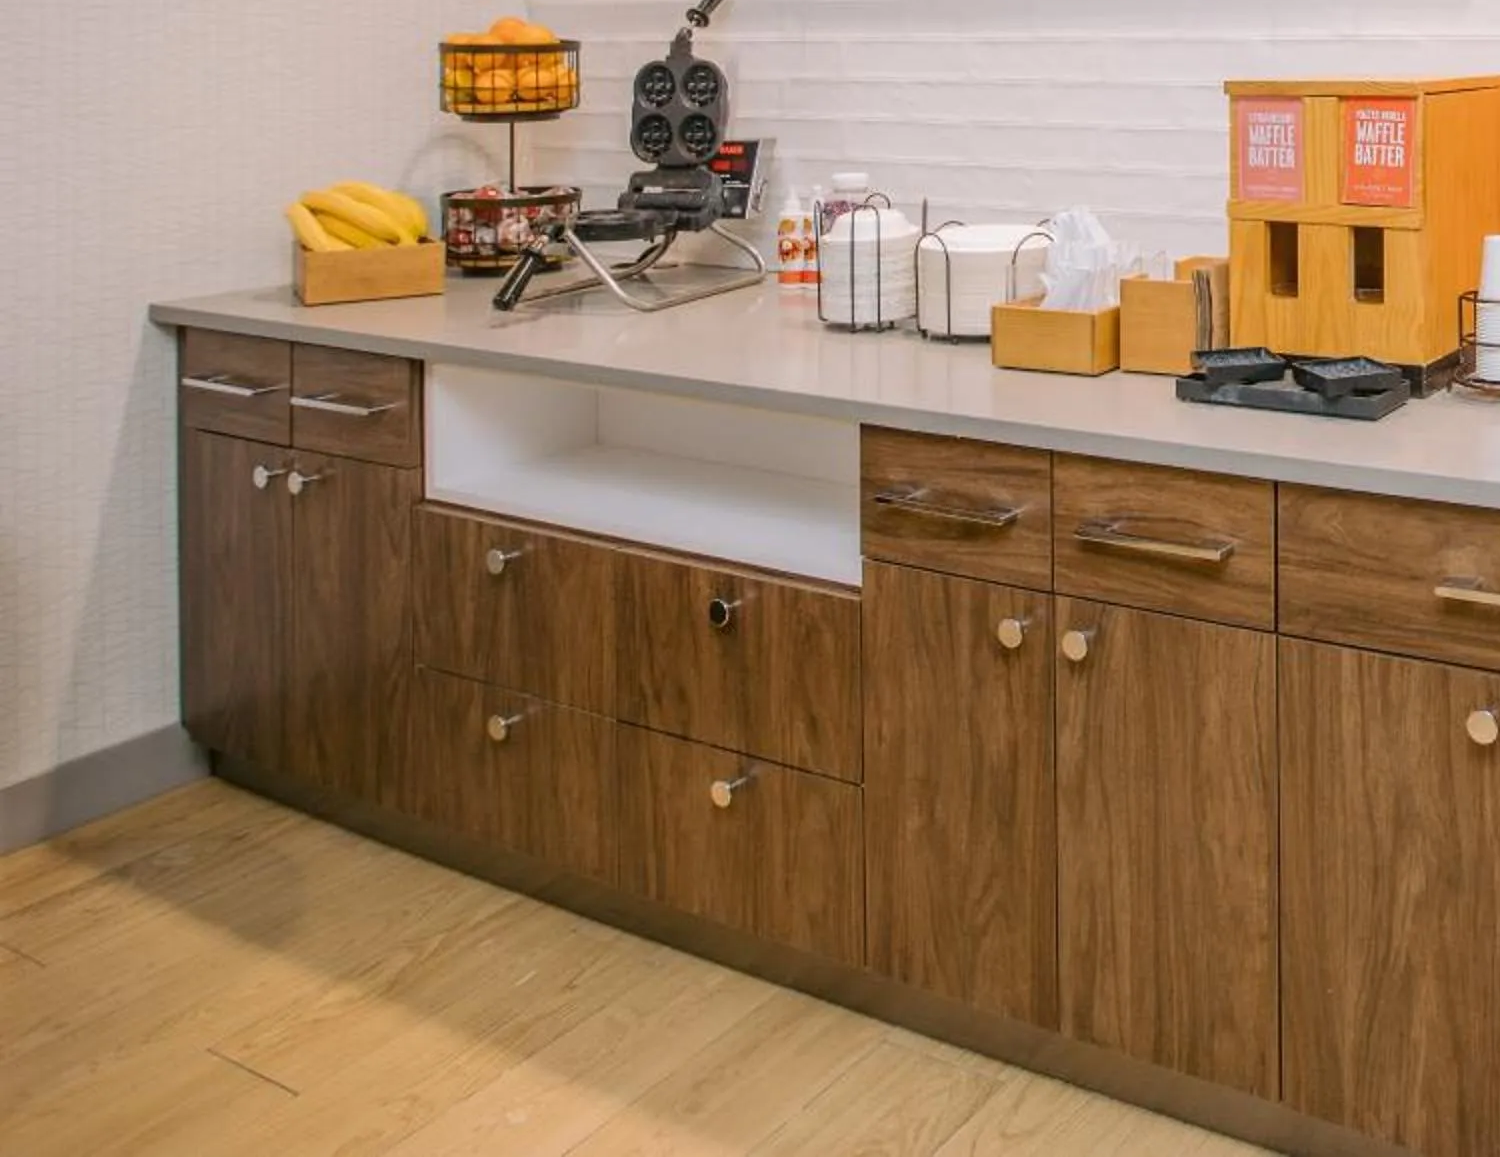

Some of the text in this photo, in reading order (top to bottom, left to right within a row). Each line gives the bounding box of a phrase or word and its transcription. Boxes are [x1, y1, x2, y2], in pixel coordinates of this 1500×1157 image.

[1248, 124, 1295, 146] WAFFLE
[1356, 120, 1405, 146] WAFFLE
[1248, 145, 1295, 168] BATTER
[1355, 143, 1404, 167] BATTER
